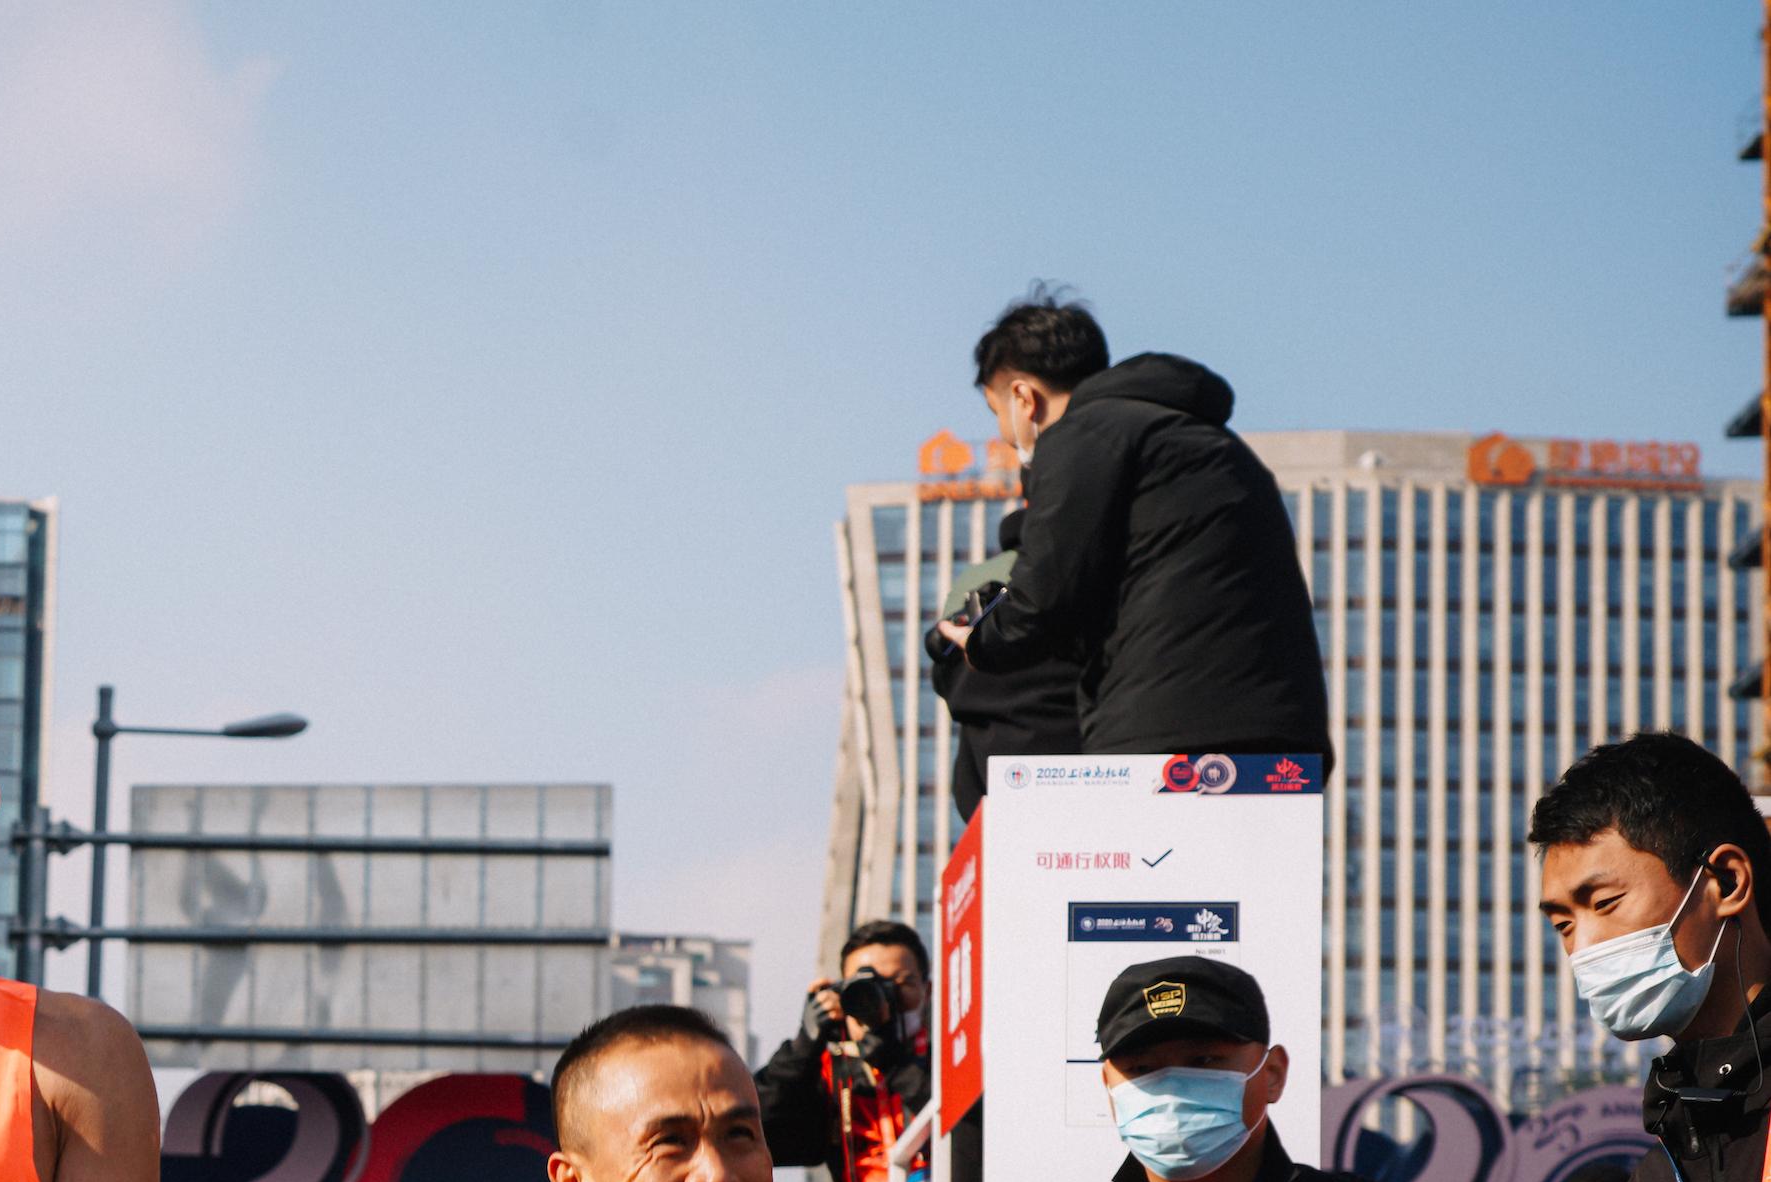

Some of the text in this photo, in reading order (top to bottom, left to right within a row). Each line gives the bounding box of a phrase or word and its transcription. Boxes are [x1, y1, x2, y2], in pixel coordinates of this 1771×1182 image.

[1036, 851, 1131, 870] 可通行权限
